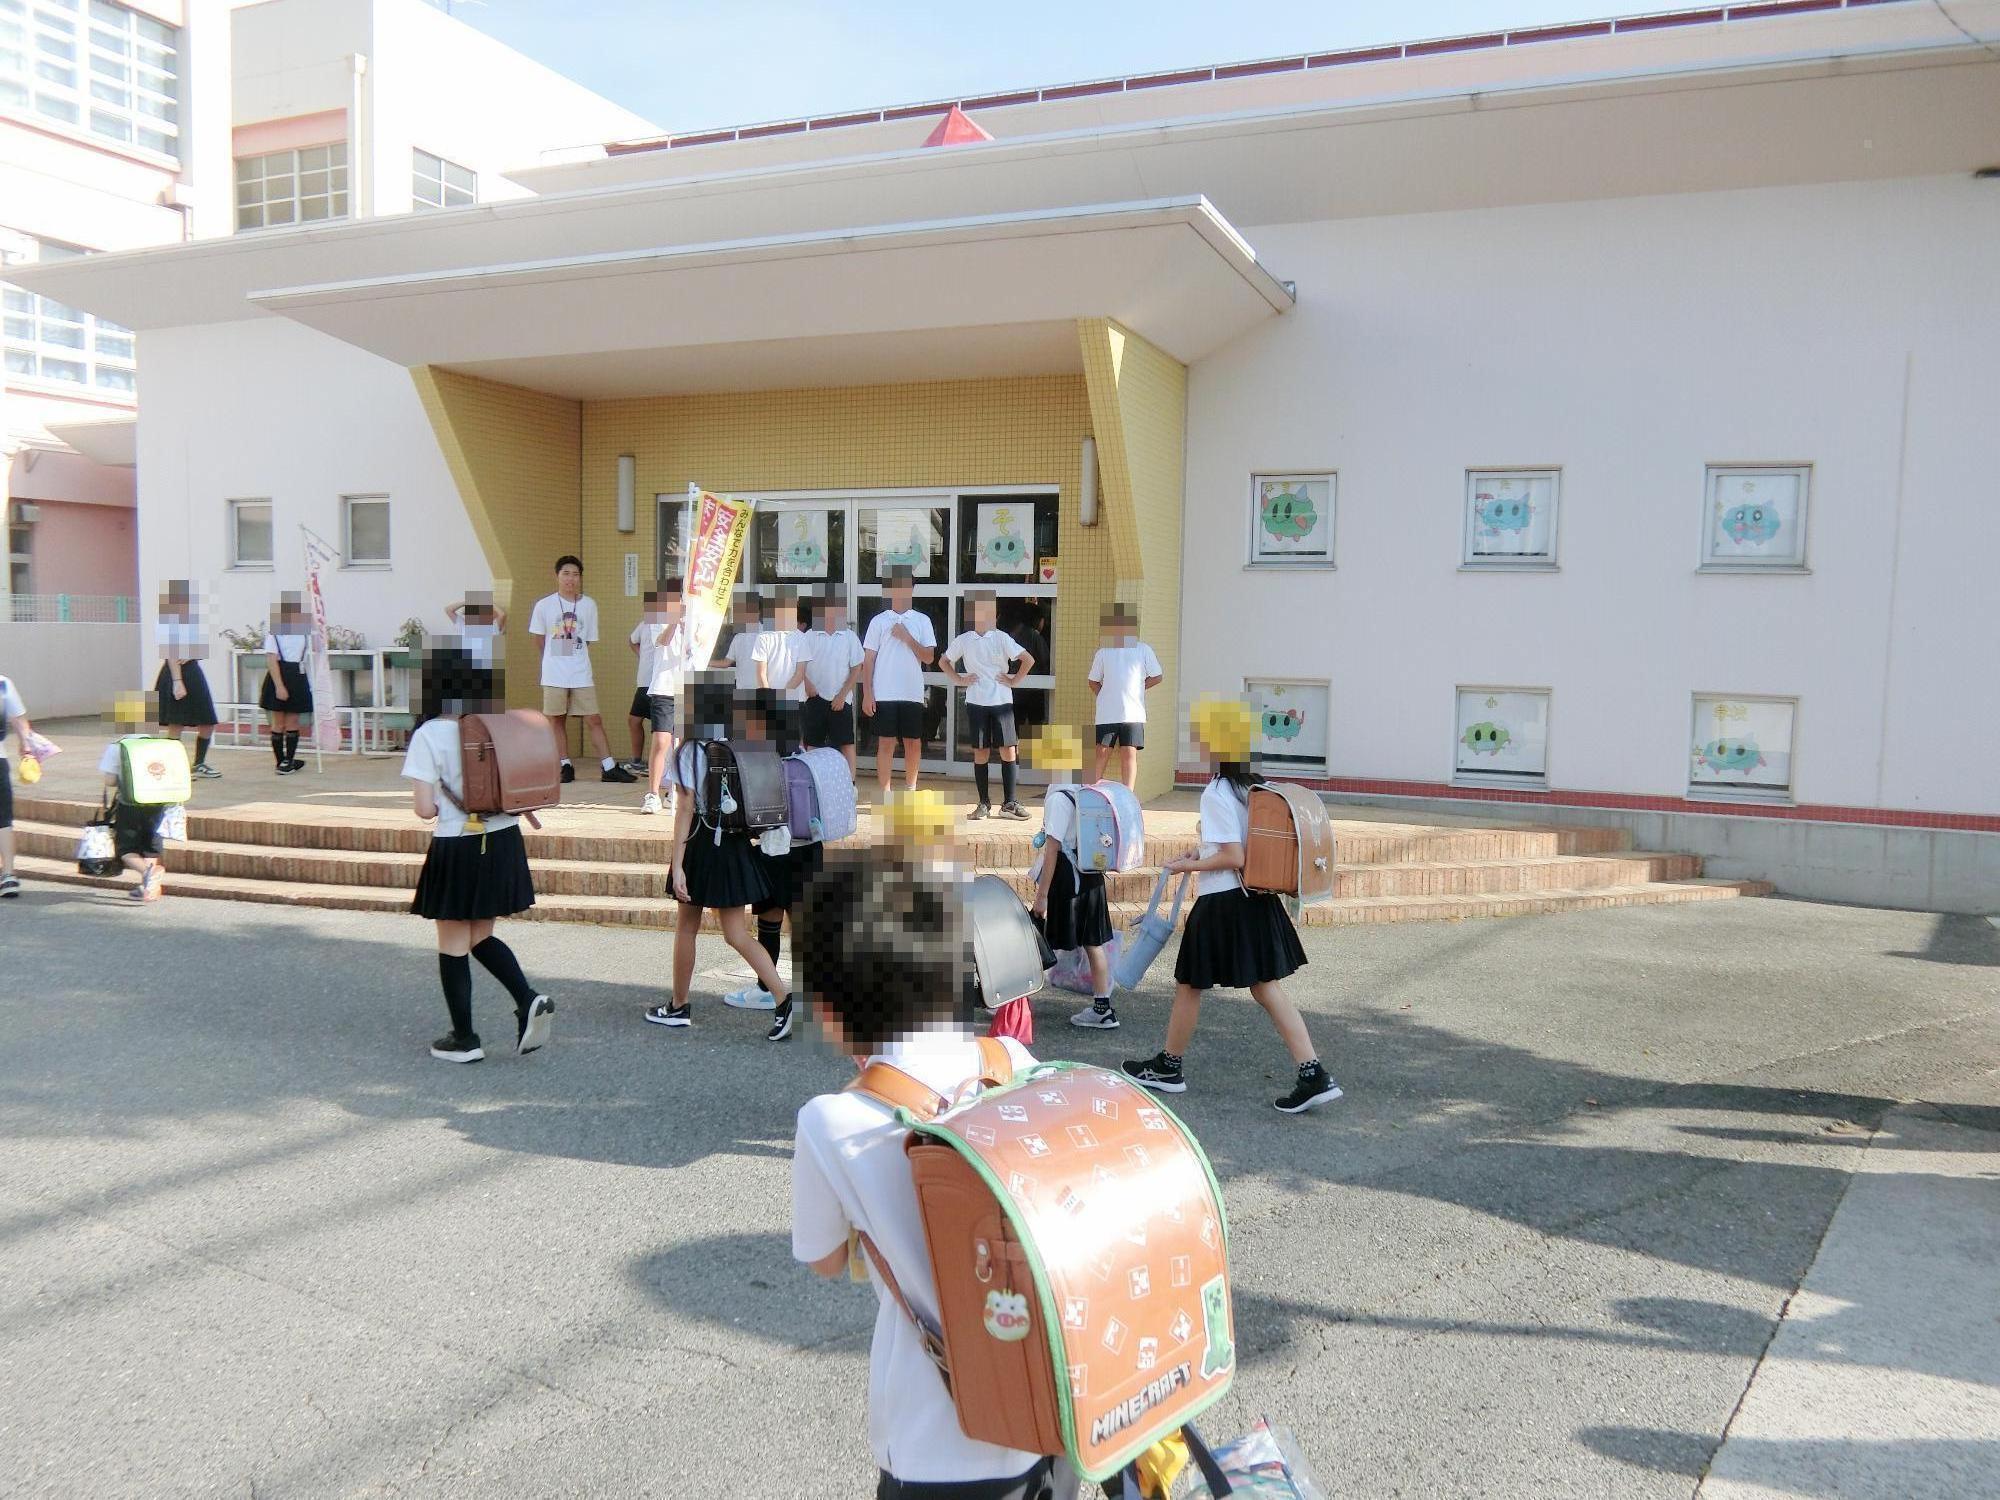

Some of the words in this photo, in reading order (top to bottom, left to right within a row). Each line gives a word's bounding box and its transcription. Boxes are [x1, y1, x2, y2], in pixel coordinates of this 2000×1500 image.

[715, 509, 749, 606] みんなで力を合わせて
[1090, 1361, 1192, 1447] MINECRAFT
